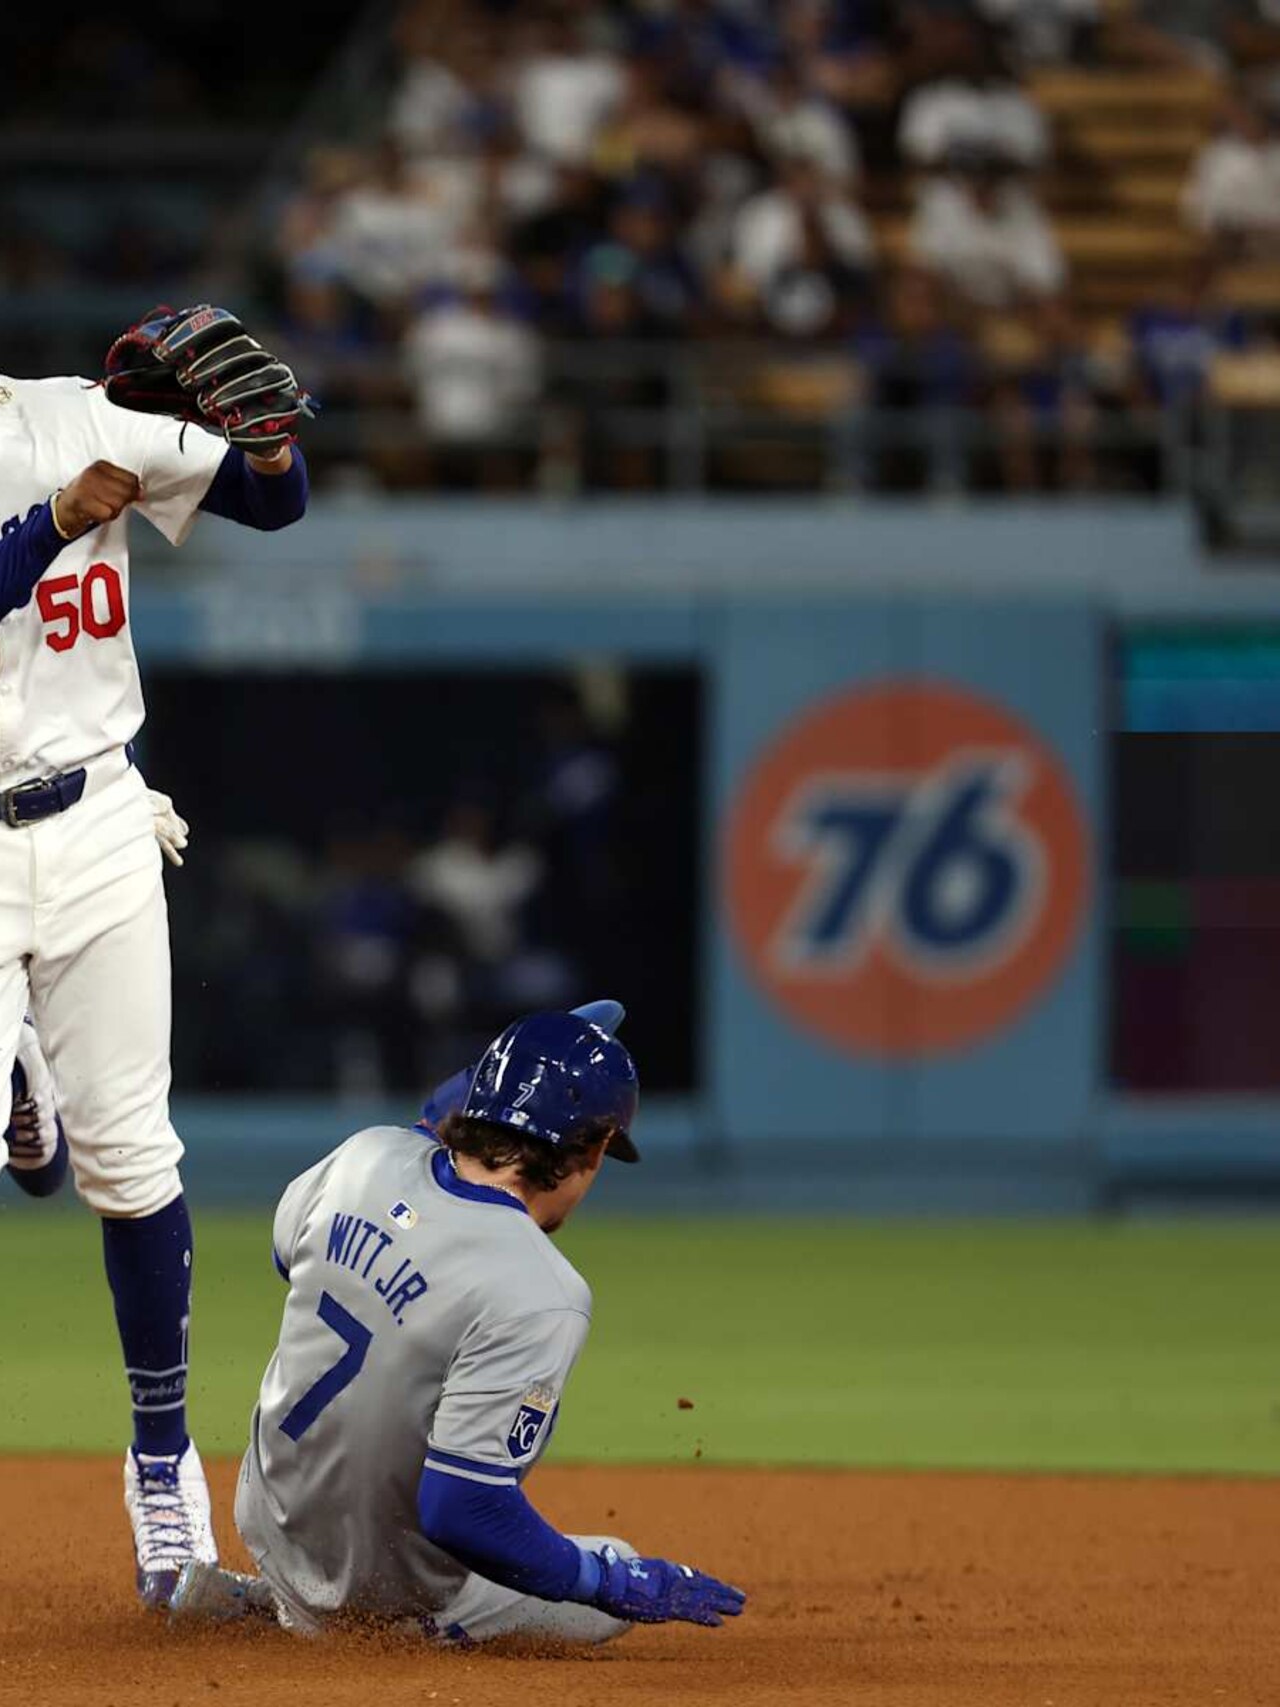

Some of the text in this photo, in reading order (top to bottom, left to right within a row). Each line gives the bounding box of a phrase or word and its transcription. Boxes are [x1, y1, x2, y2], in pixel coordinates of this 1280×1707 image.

[36, 562, 126, 653] 50
[774, 755, 1045, 978] 76
[512, 1082, 535, 1108] 7
[326, 1212, 428, 1326] WITT JR.
[278, 1290, 373, 1442] 7
[510, 1411, 539, 1450] KC
